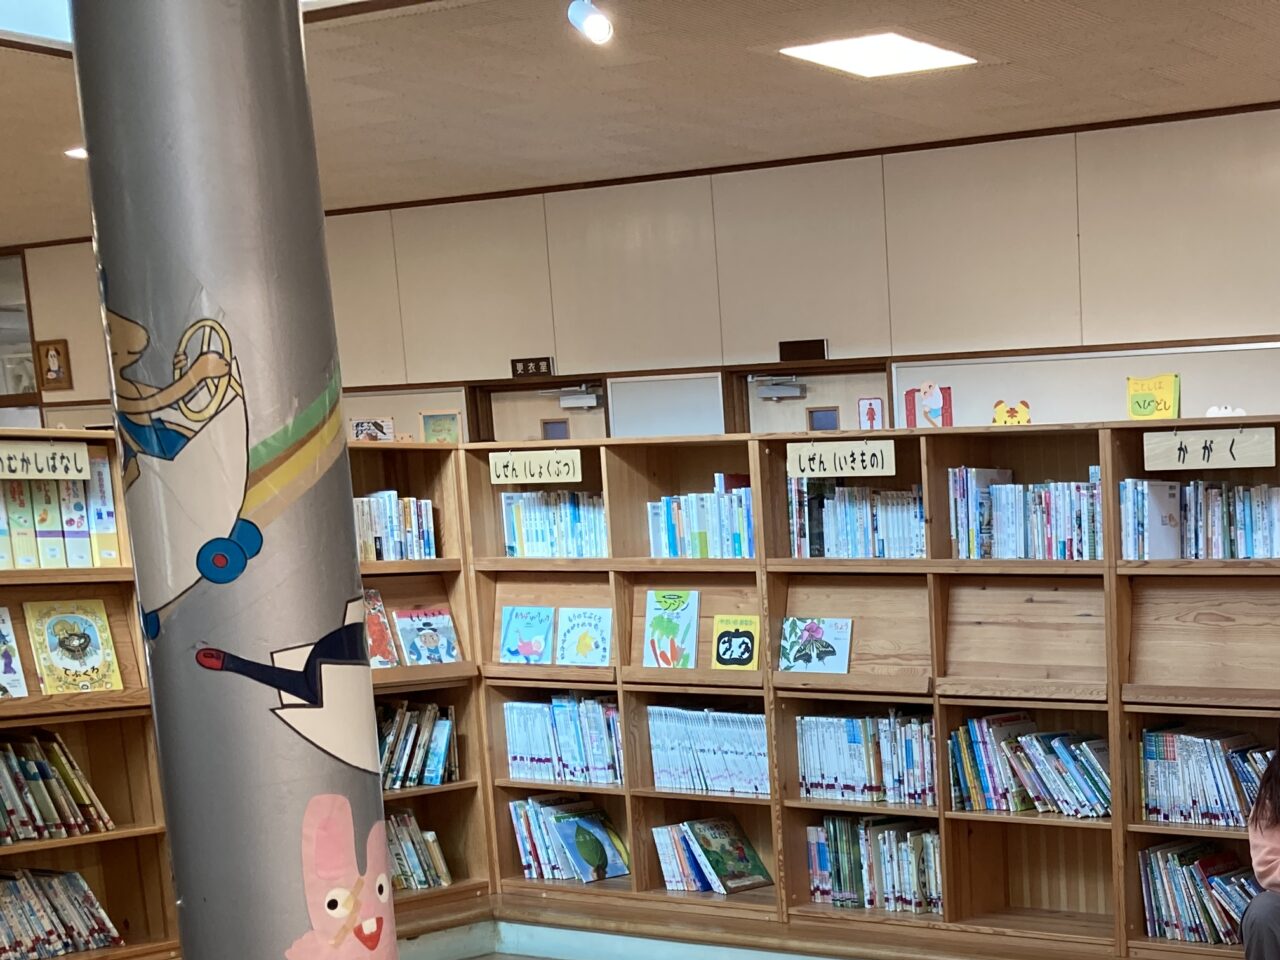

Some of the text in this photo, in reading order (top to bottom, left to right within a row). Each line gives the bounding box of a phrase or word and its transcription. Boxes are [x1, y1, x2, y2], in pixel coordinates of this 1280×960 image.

[516, 361, 548, 374] 更衣室
[1135, 399, 1171, 411] へびどし
[1177, 438, 1236, 464] かがく
[653, 600, 690, 611] ニンジン
